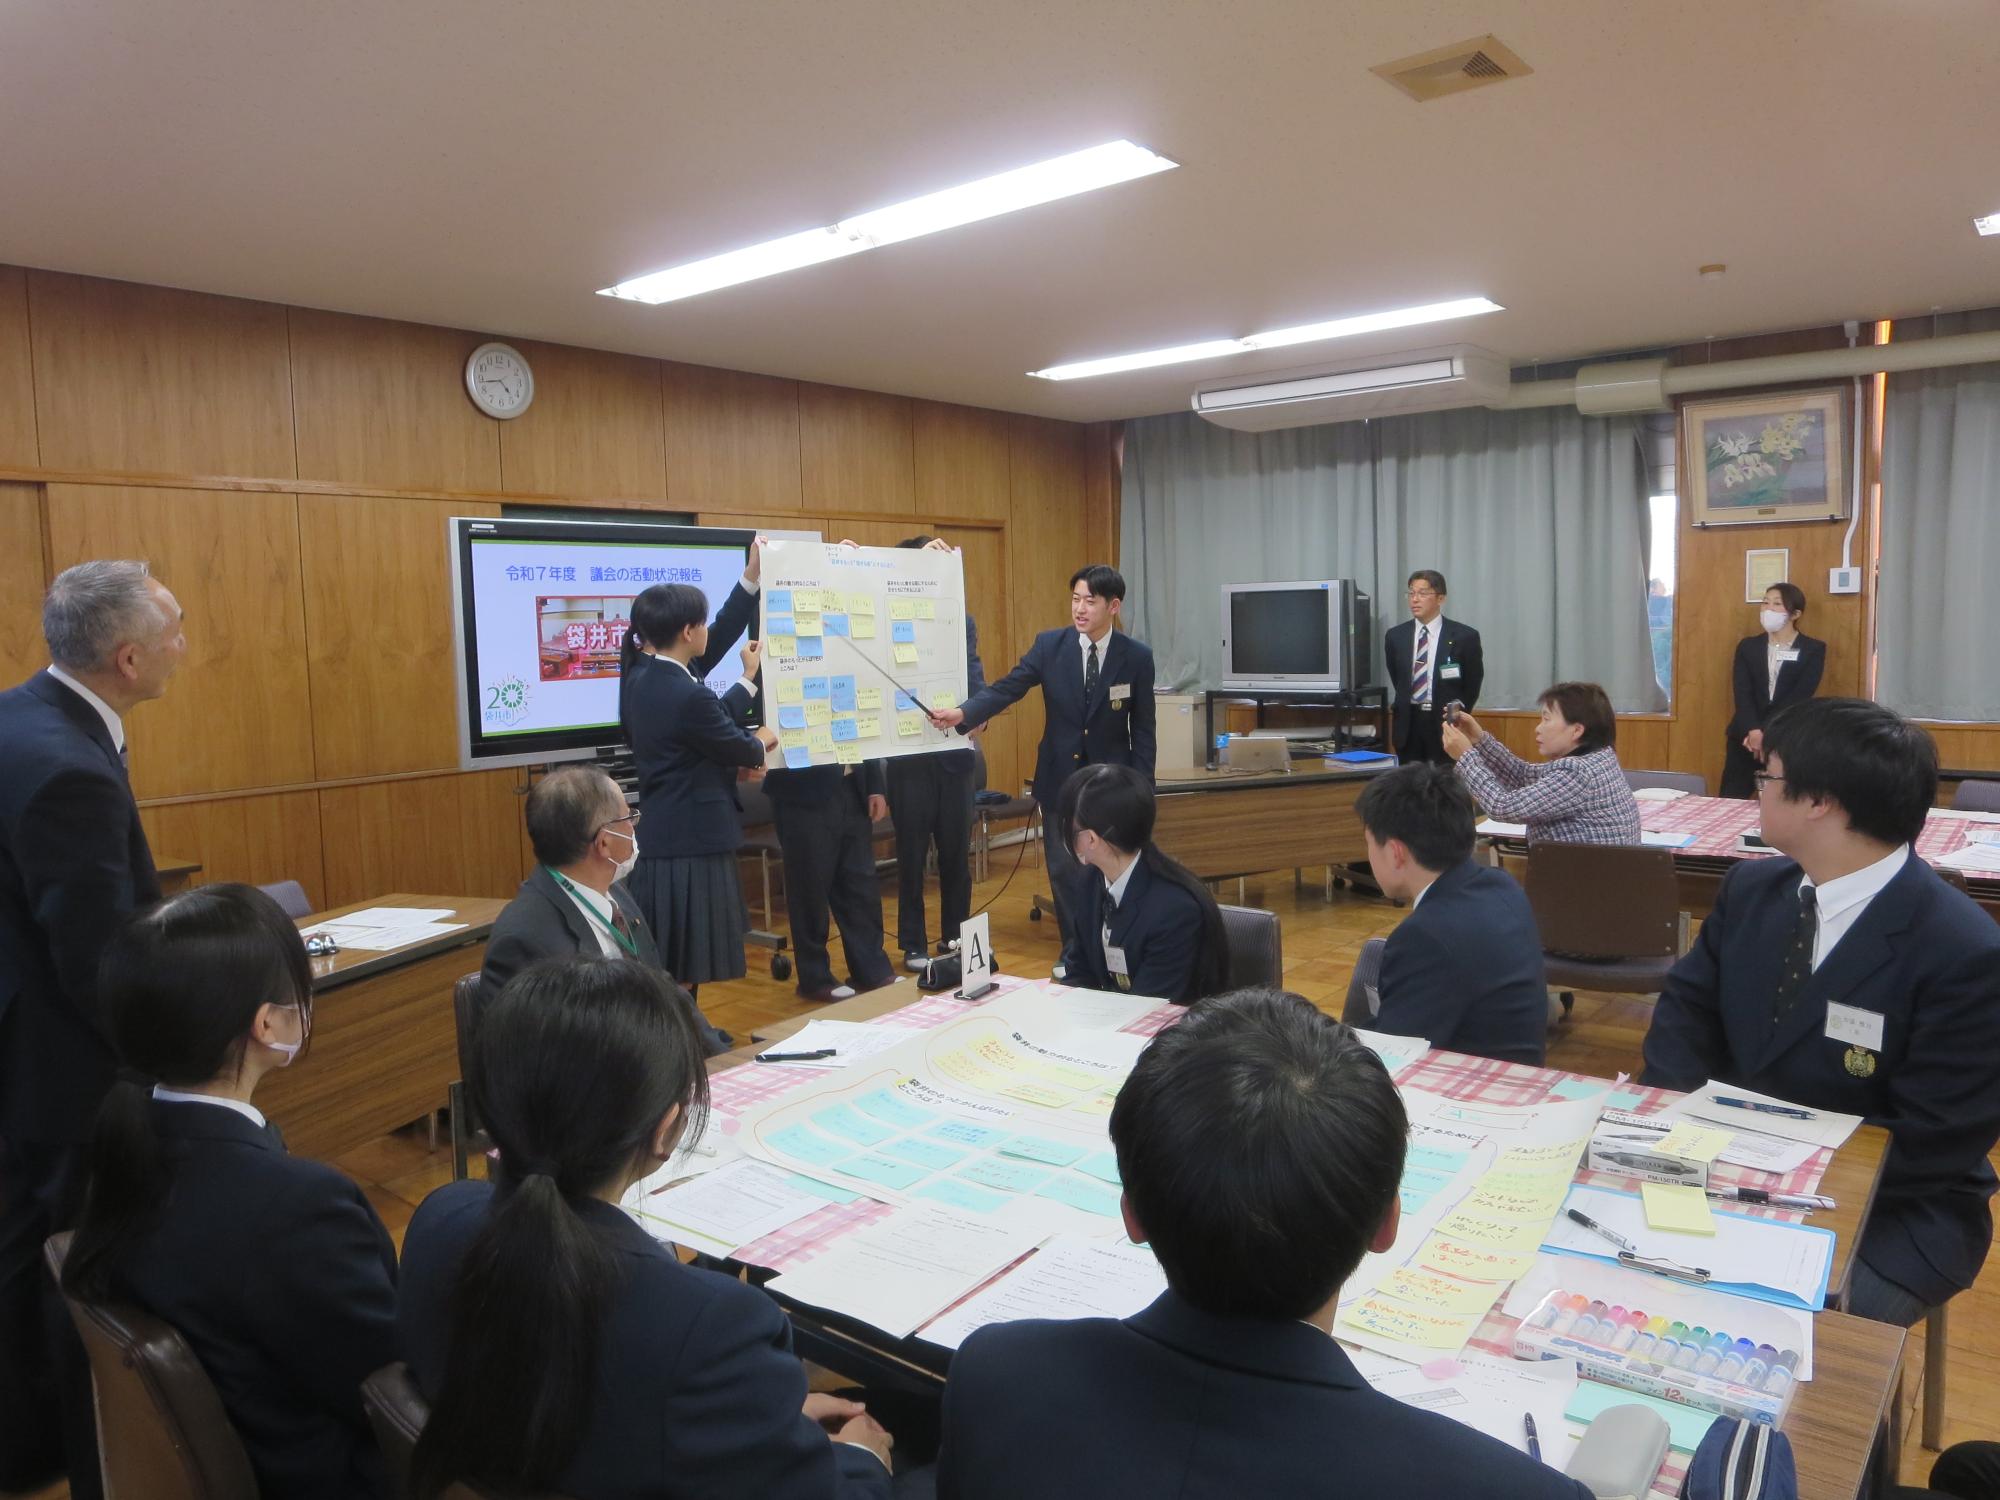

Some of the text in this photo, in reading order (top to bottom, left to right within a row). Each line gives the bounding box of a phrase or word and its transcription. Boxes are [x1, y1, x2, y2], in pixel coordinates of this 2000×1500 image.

[505, 565, 703, 582] 令和7年度 議会の活動状況報告
[567, 624, 642, 649] 袋井市
[967, 932, 986, 974] A
